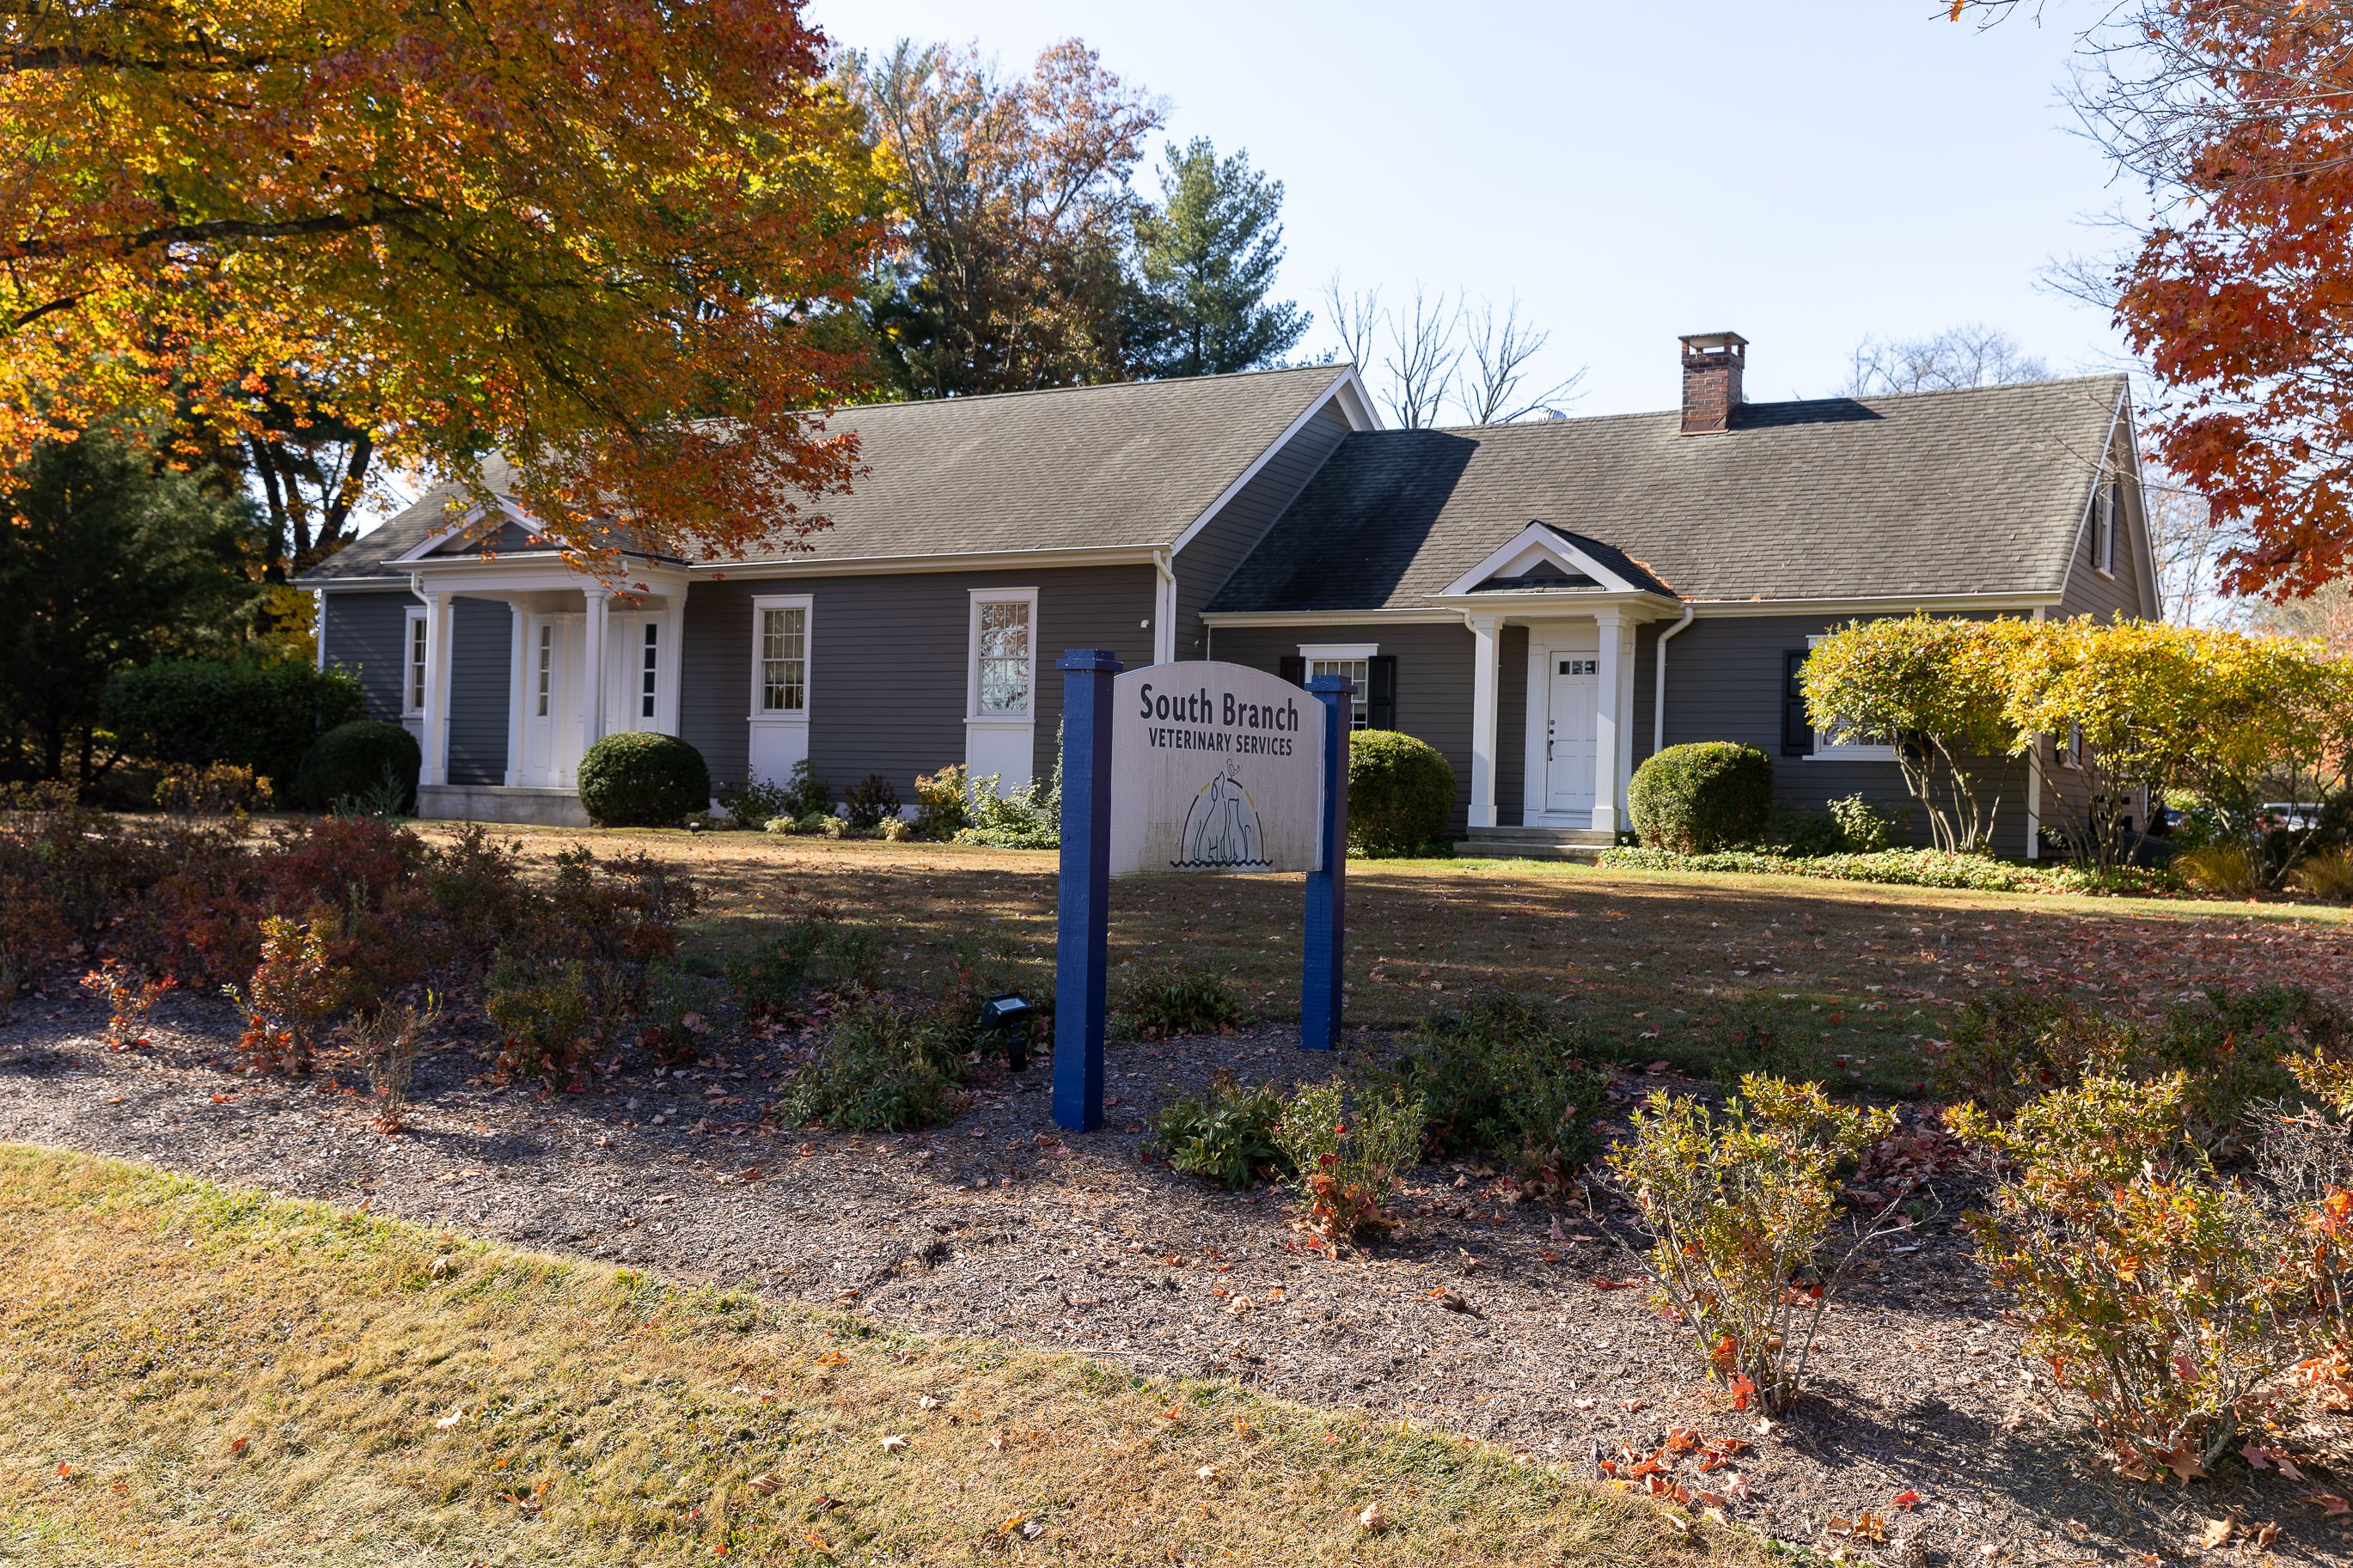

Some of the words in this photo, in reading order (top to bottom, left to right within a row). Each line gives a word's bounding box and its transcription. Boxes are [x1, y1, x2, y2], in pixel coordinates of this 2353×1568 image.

[1140, 683, 1213, 723] South
[1223, 692, 1299, 731] Branch
[1148, 727, 1232, 753] VETERINARY
[1236, 735, 1293, 756] SERVICES
